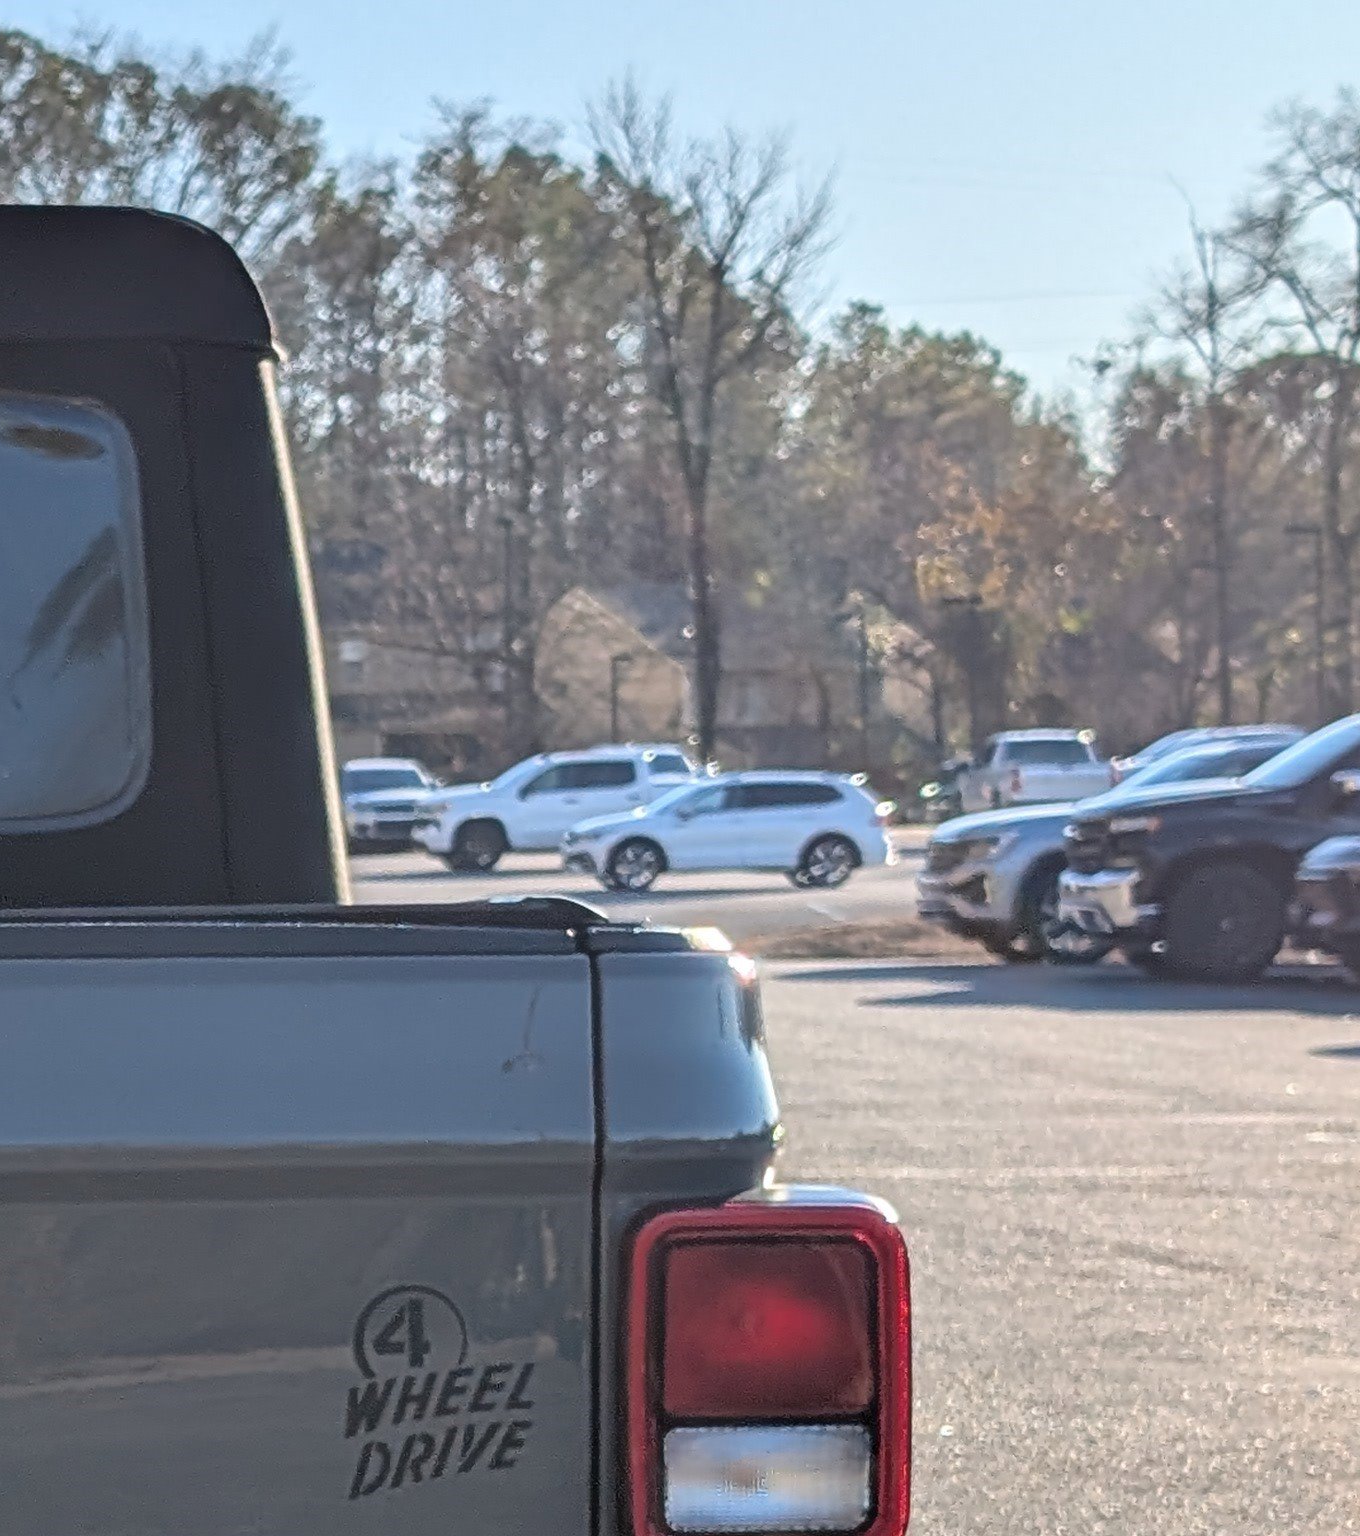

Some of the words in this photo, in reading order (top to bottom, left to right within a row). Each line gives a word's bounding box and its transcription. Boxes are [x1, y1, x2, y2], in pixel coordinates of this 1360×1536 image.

[372, 1299, 431, 1368] 4
[344, 1362, 535, 1439] WHEEL
[348, 1419, 533, 1501] DRIVE
